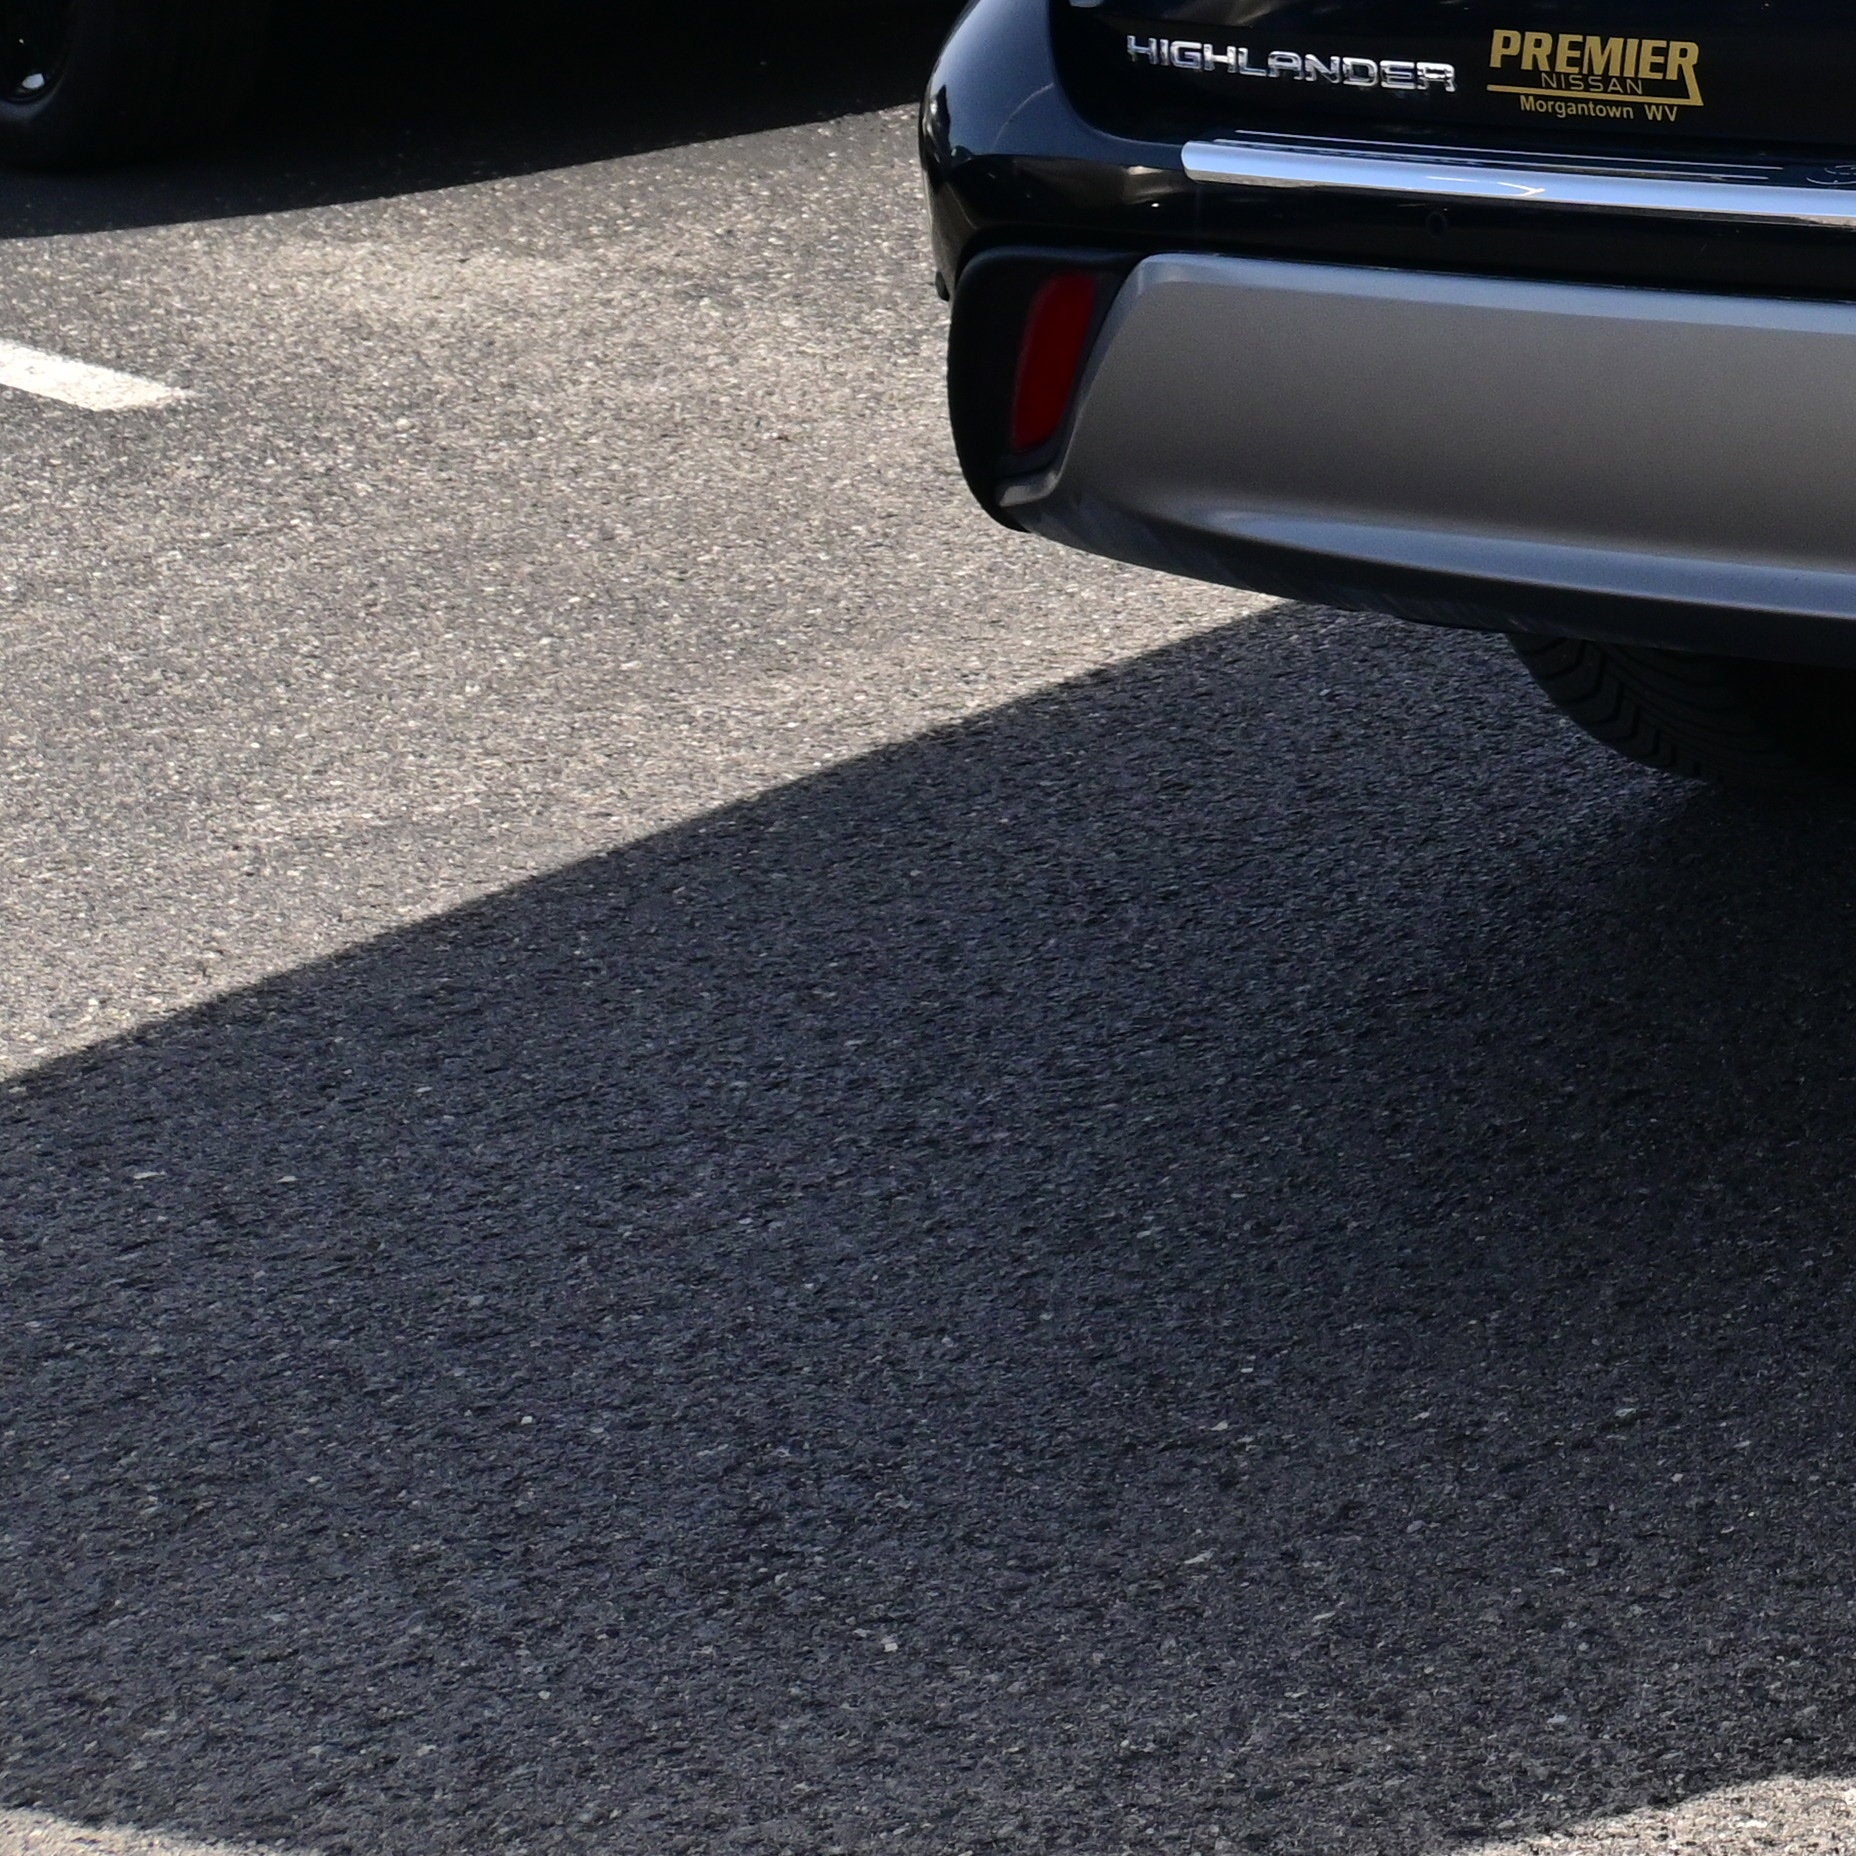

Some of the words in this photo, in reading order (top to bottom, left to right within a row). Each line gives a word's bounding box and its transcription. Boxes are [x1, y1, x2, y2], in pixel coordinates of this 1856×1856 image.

[1126, 34, 1458, 93] HIGHLANDER
[1489, 29, 1702, 91] PREMIER
[1541, 72, 1643, 95] NISSAN
[1520, 95, 1634, 119] Morgantown
[1644, 104, 1677, 122] WV
